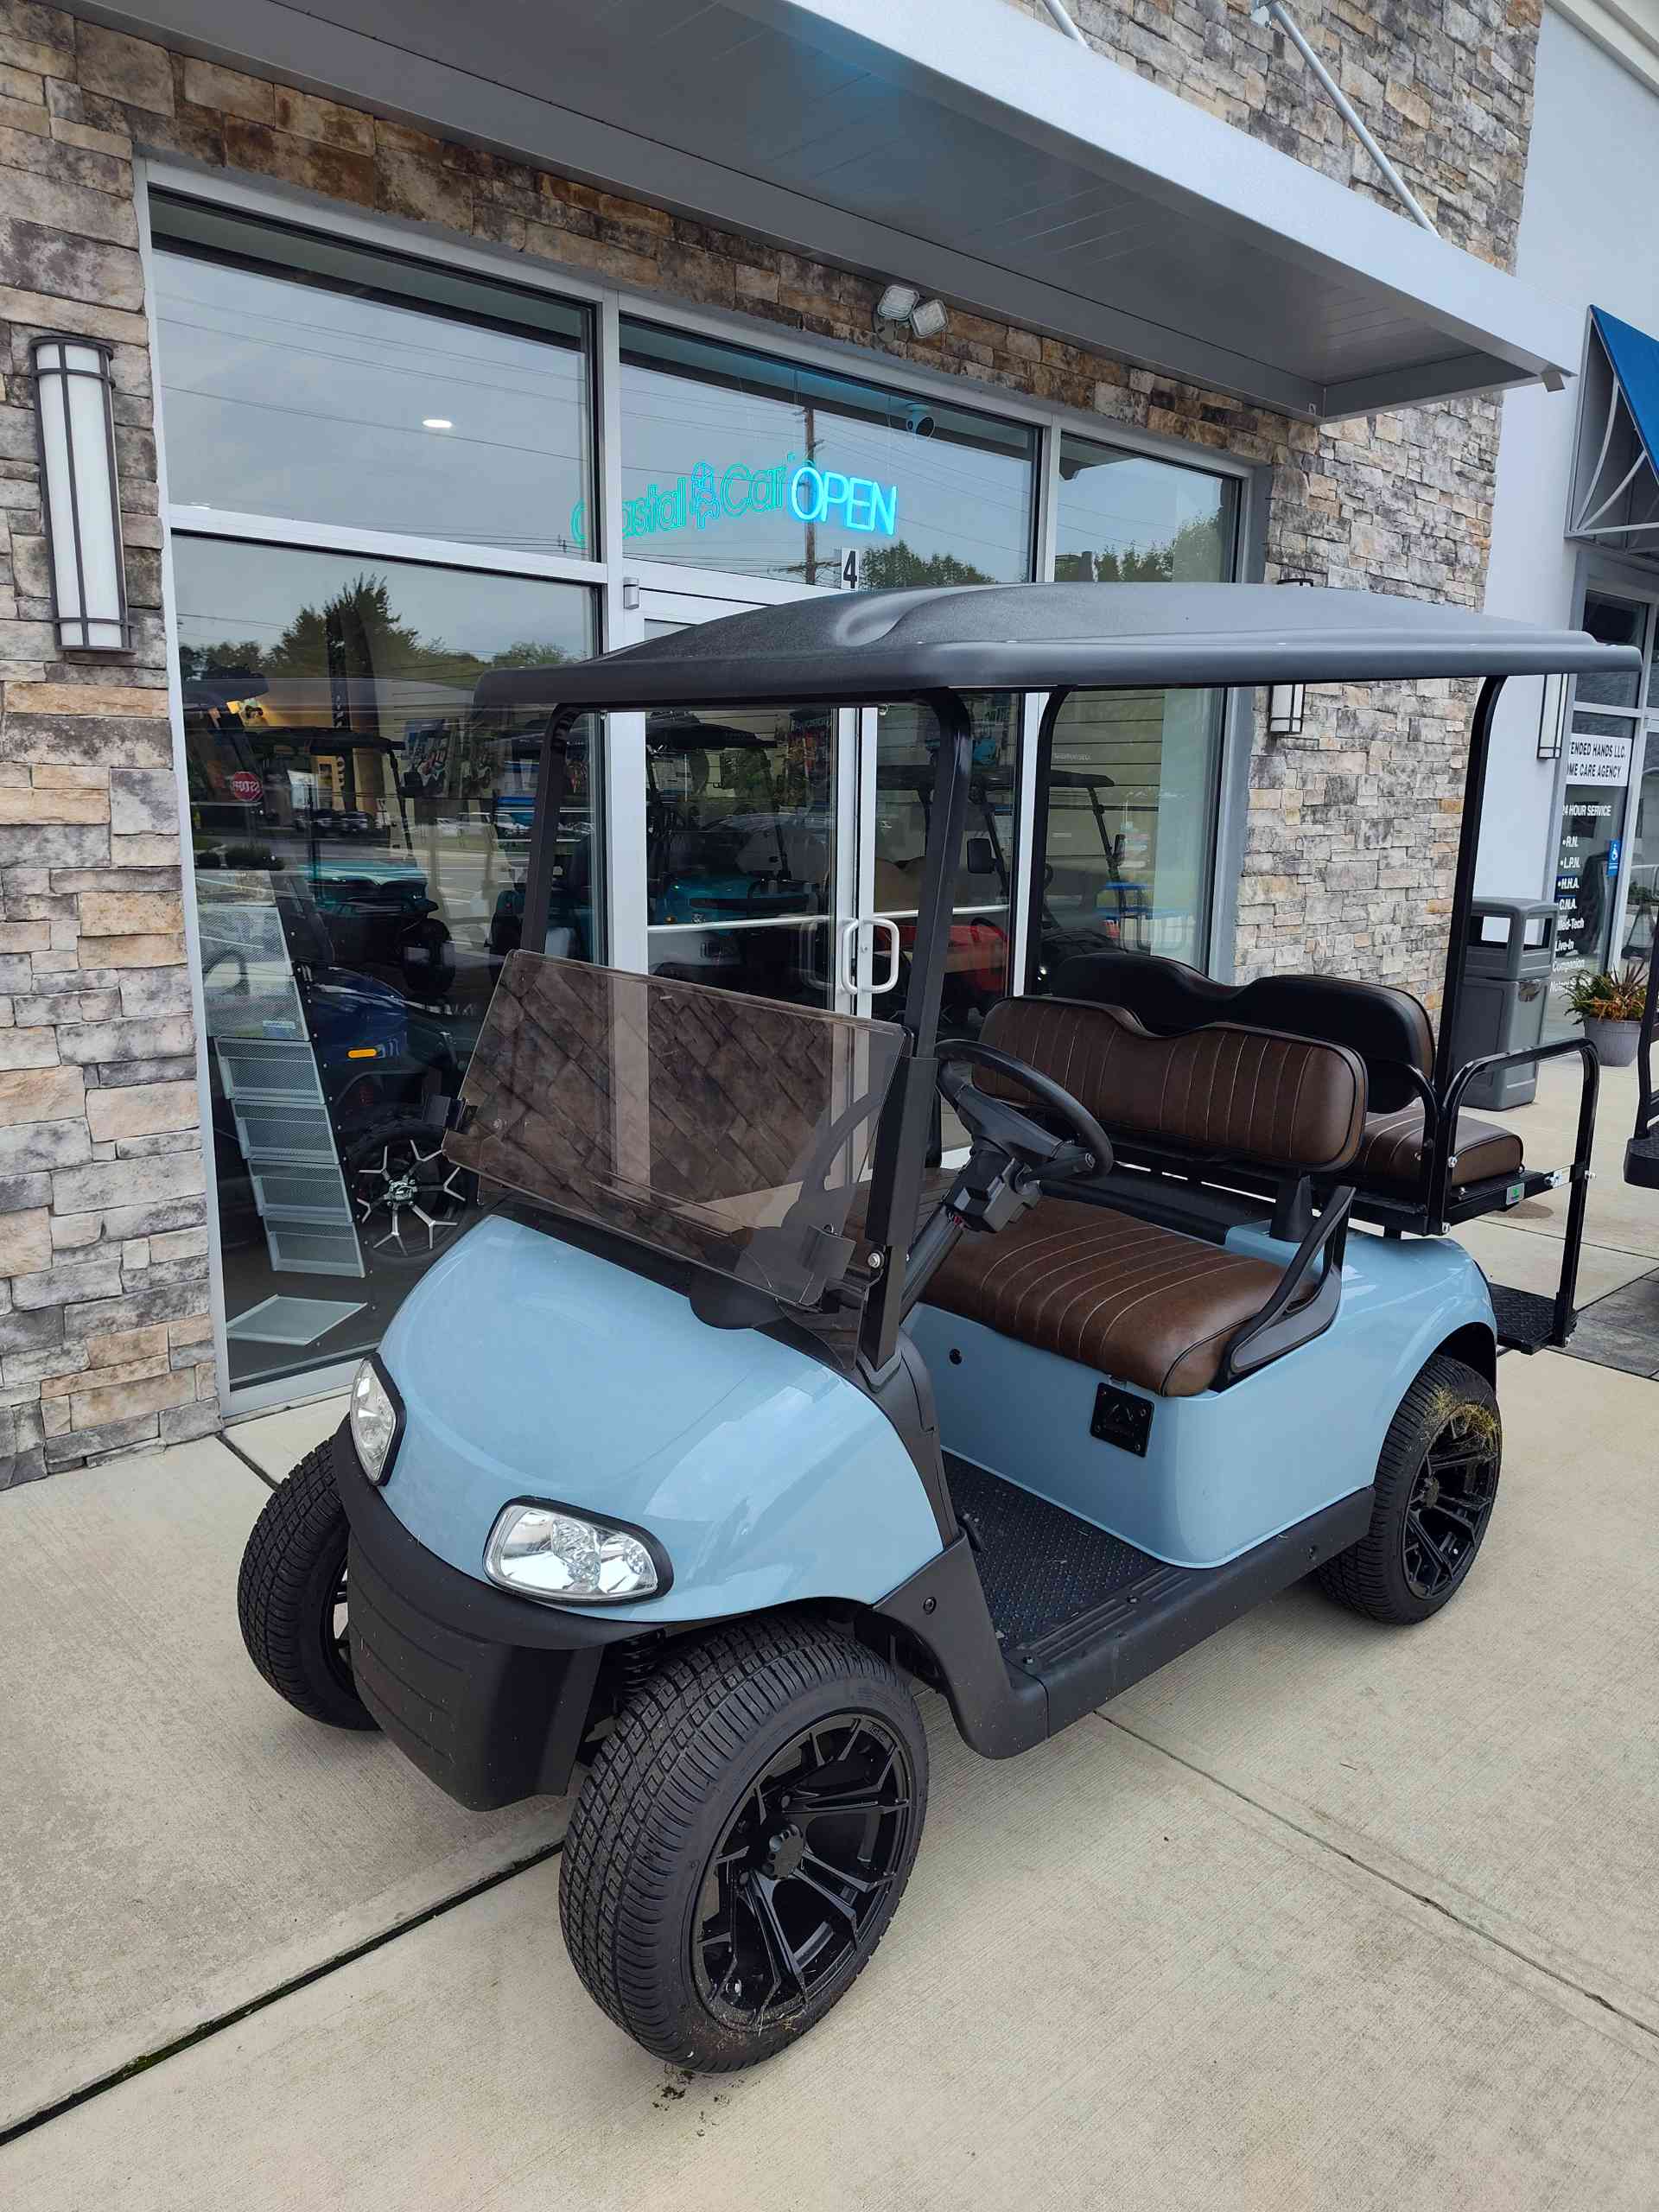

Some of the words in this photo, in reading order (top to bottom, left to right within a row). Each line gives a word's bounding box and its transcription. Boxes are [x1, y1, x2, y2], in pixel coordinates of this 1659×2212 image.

[791, 467, 898, 537] OPEN
[842, 550, 858, 589] 4
[1592, 743, 1613, 758] HANDS
[1580, 764, 1597, 777] CARE
[1597, 765, 1622, 779] AGENCY
[1569, 804, 1587, 816] HOUR
[1587, 805, 1612, 817] SERVICE
